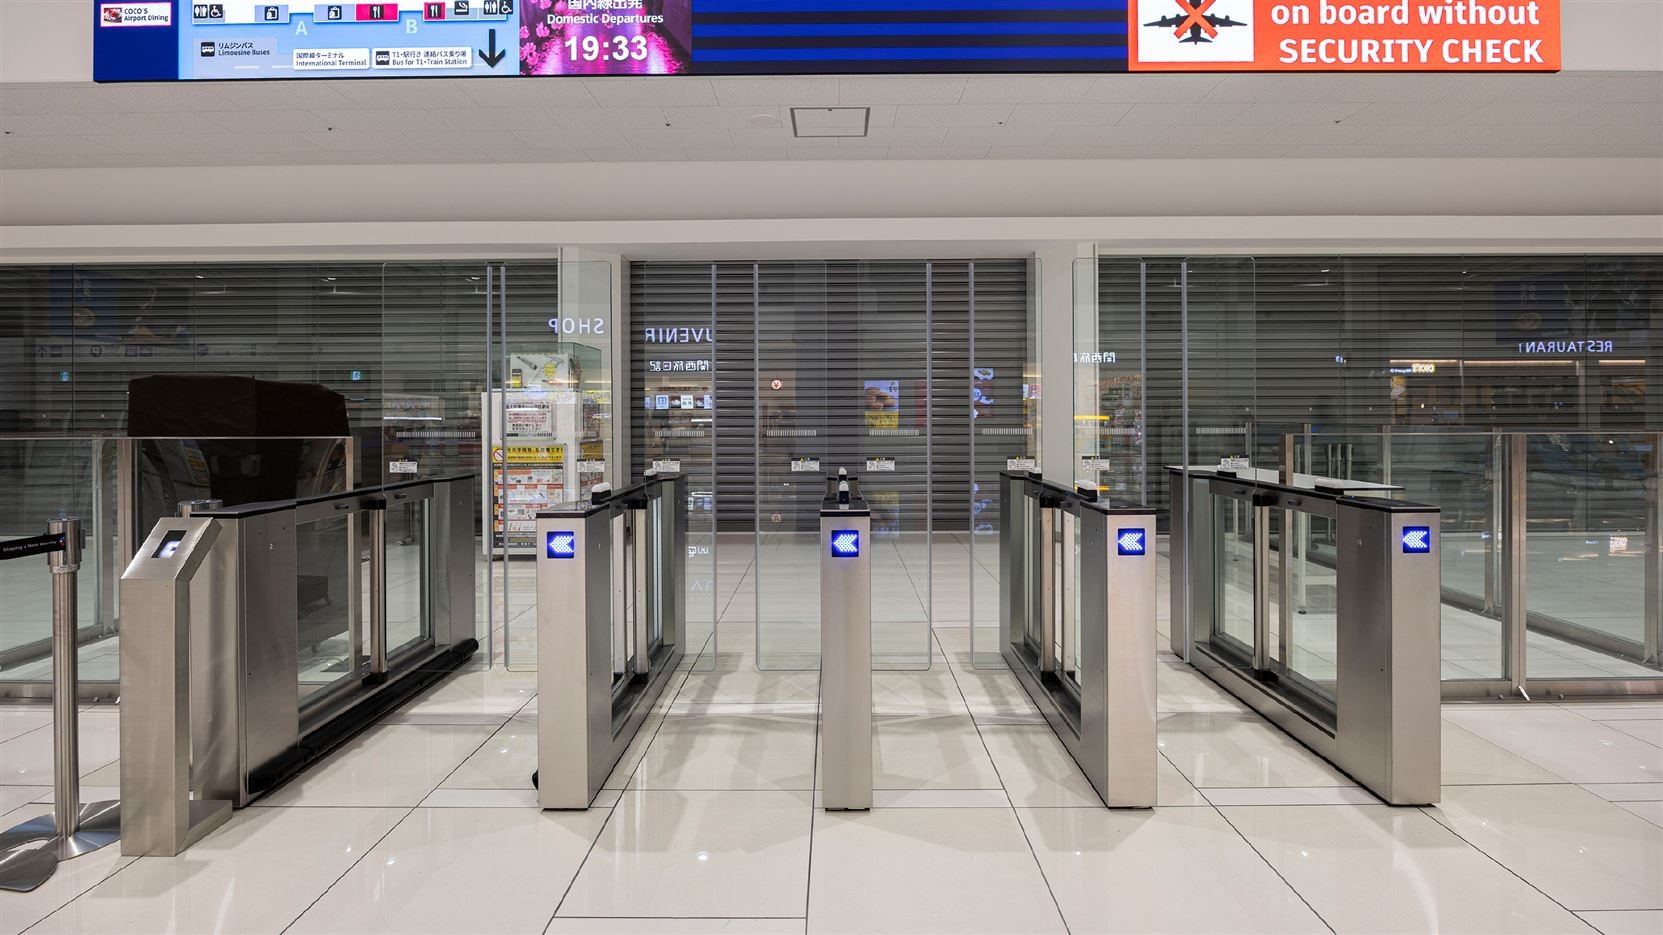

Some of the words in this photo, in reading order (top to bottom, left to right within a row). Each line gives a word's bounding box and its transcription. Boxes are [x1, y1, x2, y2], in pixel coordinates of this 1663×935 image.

[547, 13, 599, 24] Domestic
[601, 13, 664, 25] Departures
[1271, 4, 1310, 25] on
[1320, 0, 1409, 25] board
[1418, 0, 1540, 25] without
[295, 20, 308, 36] A
[406, 19, 418, 34] B
[564, 35, 648, 61] 19:33
[1279, 38, 1434, 64] SECURITY
[1442, 38, 1544, 64] CHECK
